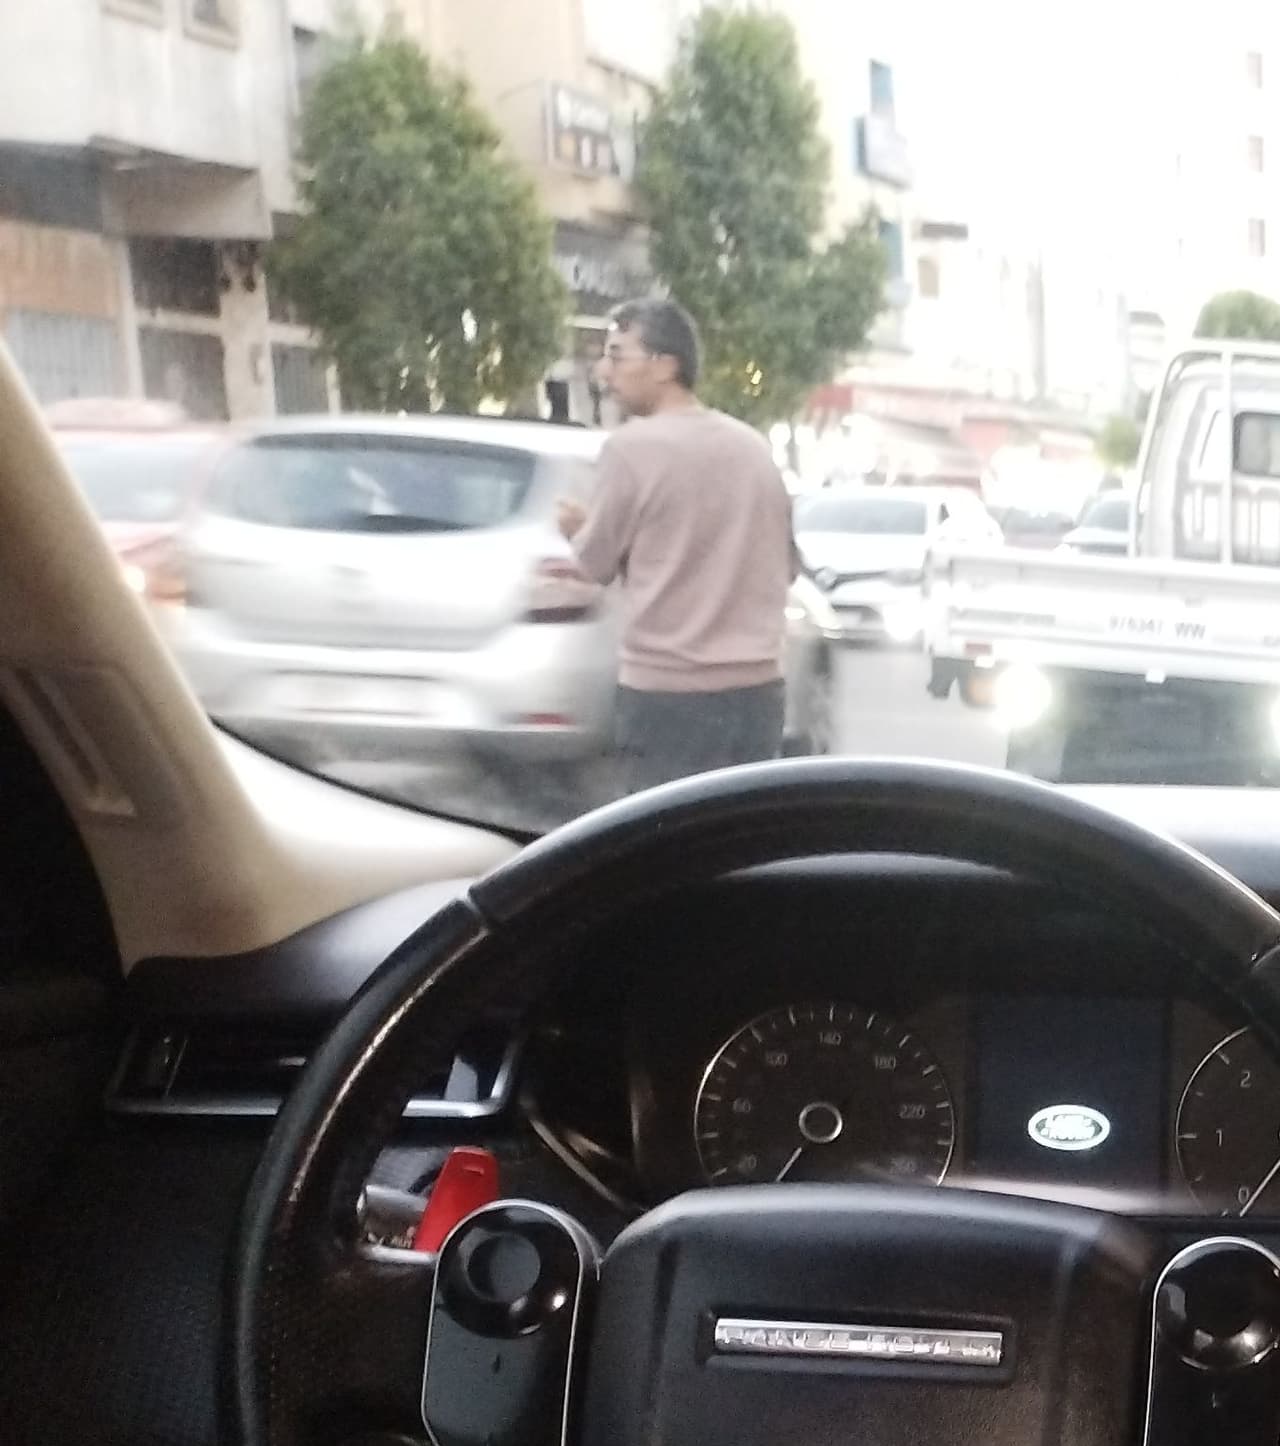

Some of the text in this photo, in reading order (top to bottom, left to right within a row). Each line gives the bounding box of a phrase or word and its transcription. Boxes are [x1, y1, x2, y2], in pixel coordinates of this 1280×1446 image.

[1240, 1070, 1251, 1088] 2
[1215, 1128, 1223, 1147] 1
[1238, 1185, 1250, 1204] 0
